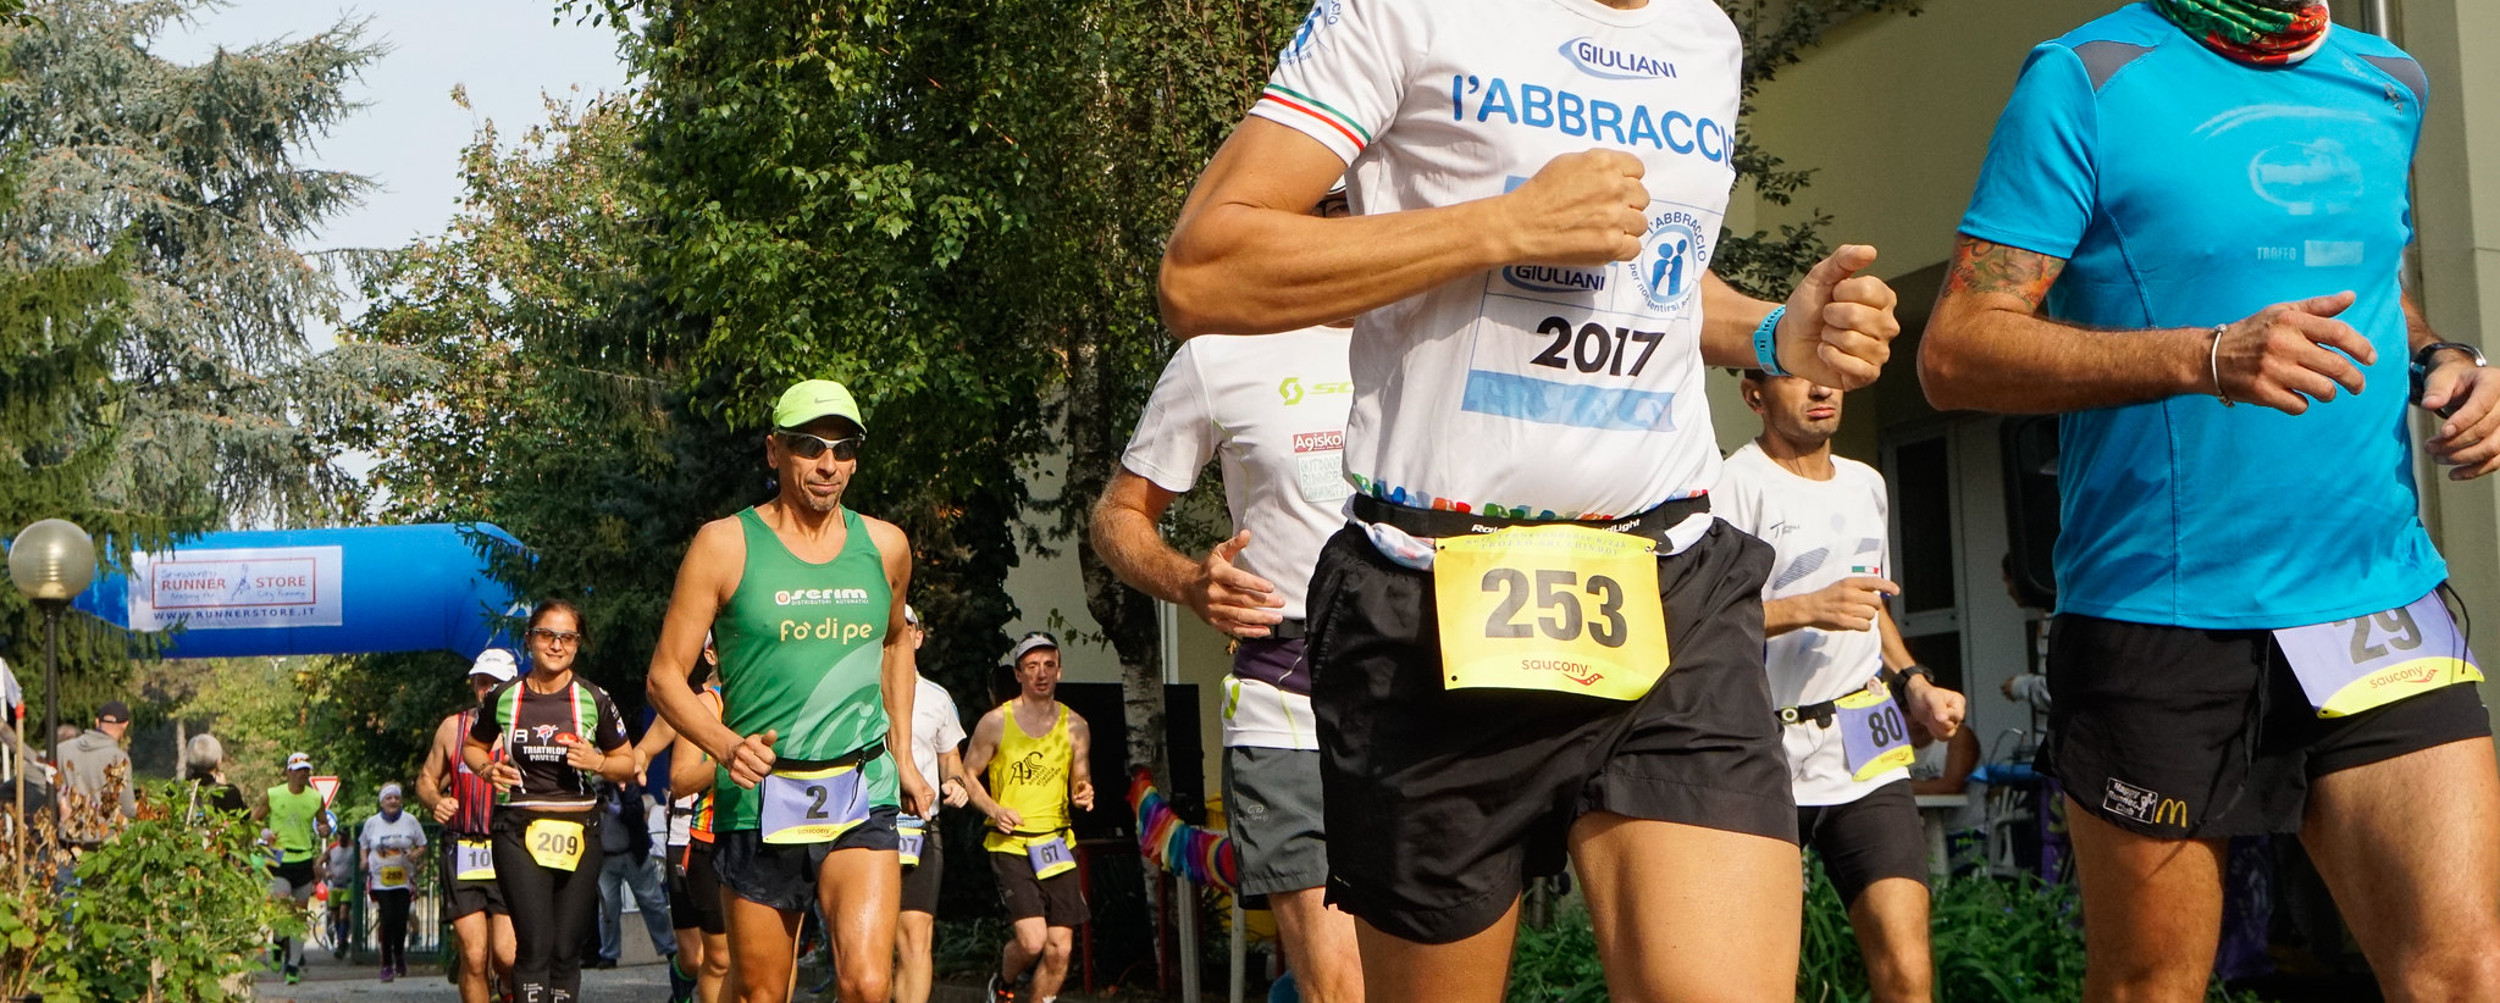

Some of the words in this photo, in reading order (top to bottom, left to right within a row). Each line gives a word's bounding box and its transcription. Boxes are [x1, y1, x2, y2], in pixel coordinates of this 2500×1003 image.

[1579, 42, 1677, 78] GIULIANI
[1516, 265, 1605, 291] GIULIANI
[1628, 263, 1640, 280] per
[1530, 316, 1666, 377] 2017
[1294, 432, 1342, 451] Agisko
[162, 578, 226, 591] RUNNER
[256, 576, 306, 588] STORE
[791, 588, 867, 600] serim
[154, 607, 315, 620] WWW.RUNNERSTORE.IT
[1482, 568, 1627, 648] 253
[815, 617, 838, 640] di
[842, 623, 872, 645] pe
[2333, 606, 2422, 664] 29
[1522, 660, 1588, 676] saucony
[2369, 665, 2424, 689] saucony
[1868, 706, 1903, 748] 80
[523, 746, 567, 755] TRIATHLON
[530, 754, 560, 762] PAVESE
[2114, 782, 2140, 799] Happy
[806, 785, 829, 819] 2
[2116, 803, 2134, 816] Club
[537, 832, 578, 856] 209
[1040, 844, 1059, 864] 67
